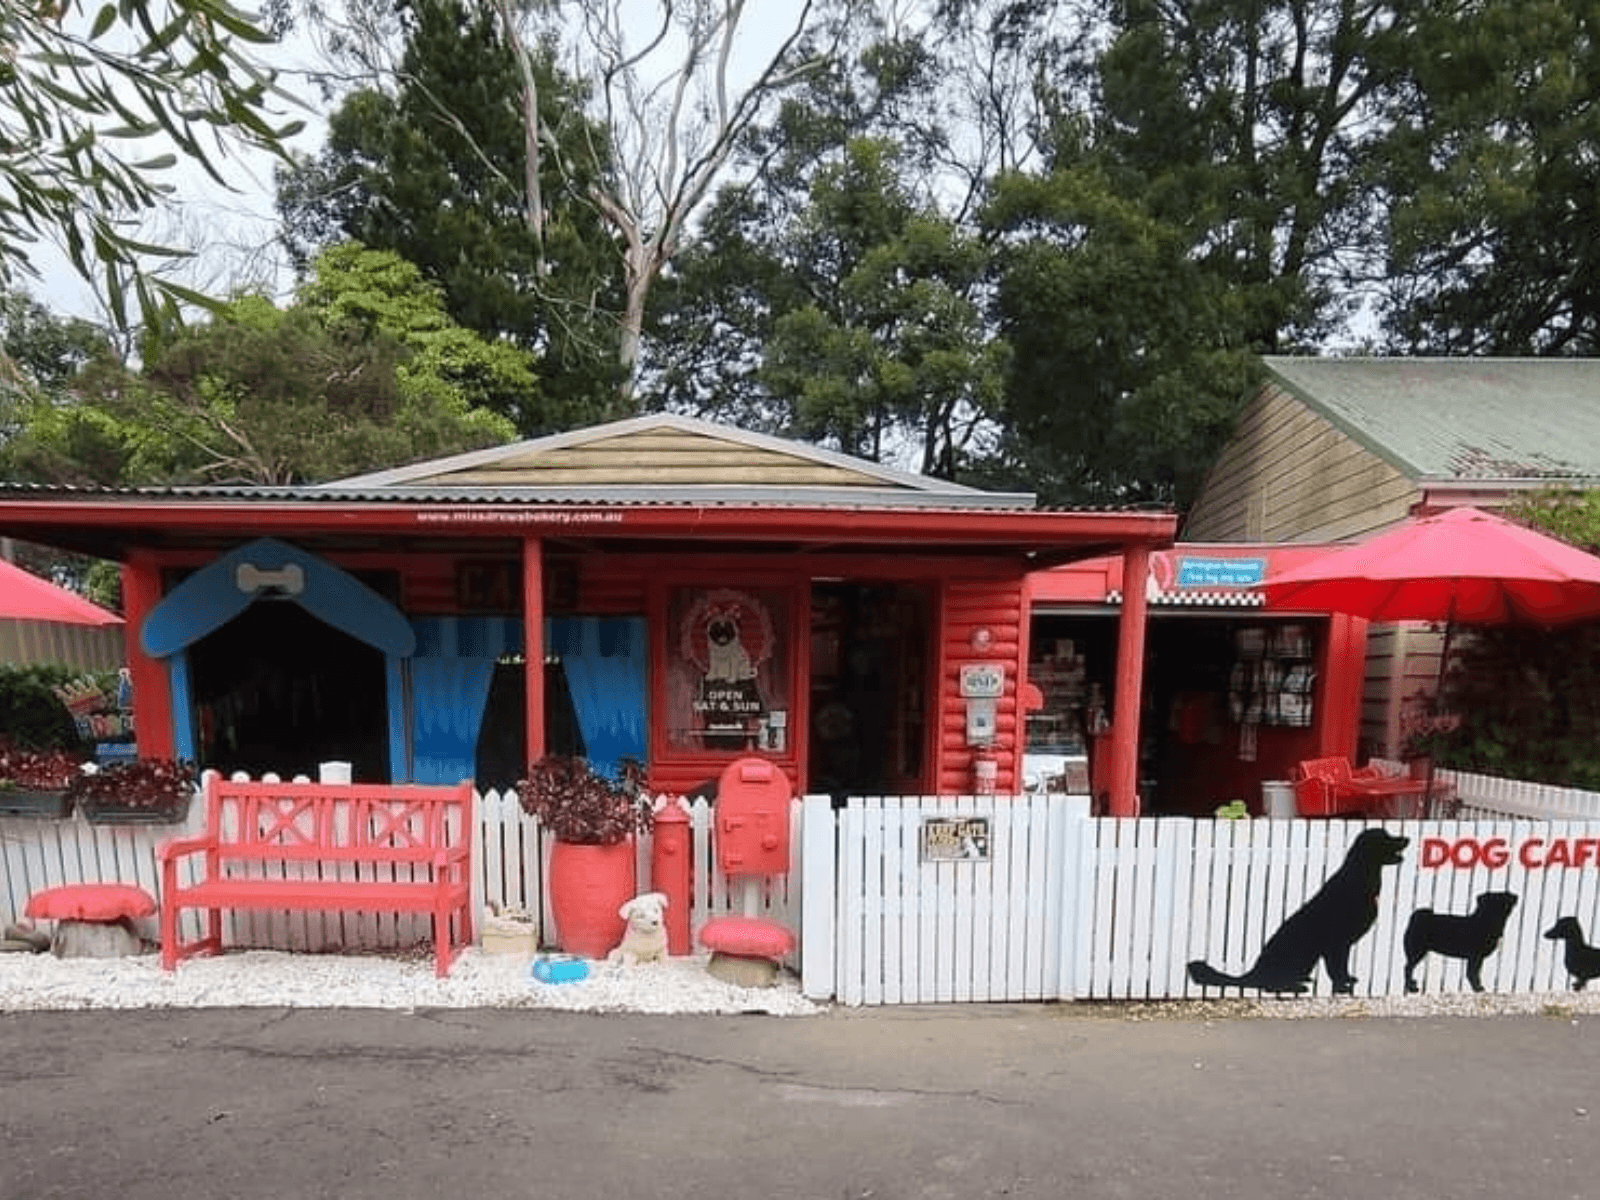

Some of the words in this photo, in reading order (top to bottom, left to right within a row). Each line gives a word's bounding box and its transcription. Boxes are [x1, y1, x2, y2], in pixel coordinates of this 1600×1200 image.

[708, 690, 744, 701] OPEN
[692, 701, 716, 711] SAT
[719, 701, 731, 711] &
[734, 701, 761, 711] SUN
[1421, 837, 1510, 869] DOG
[1518, 837, 1600, 869] CAF
